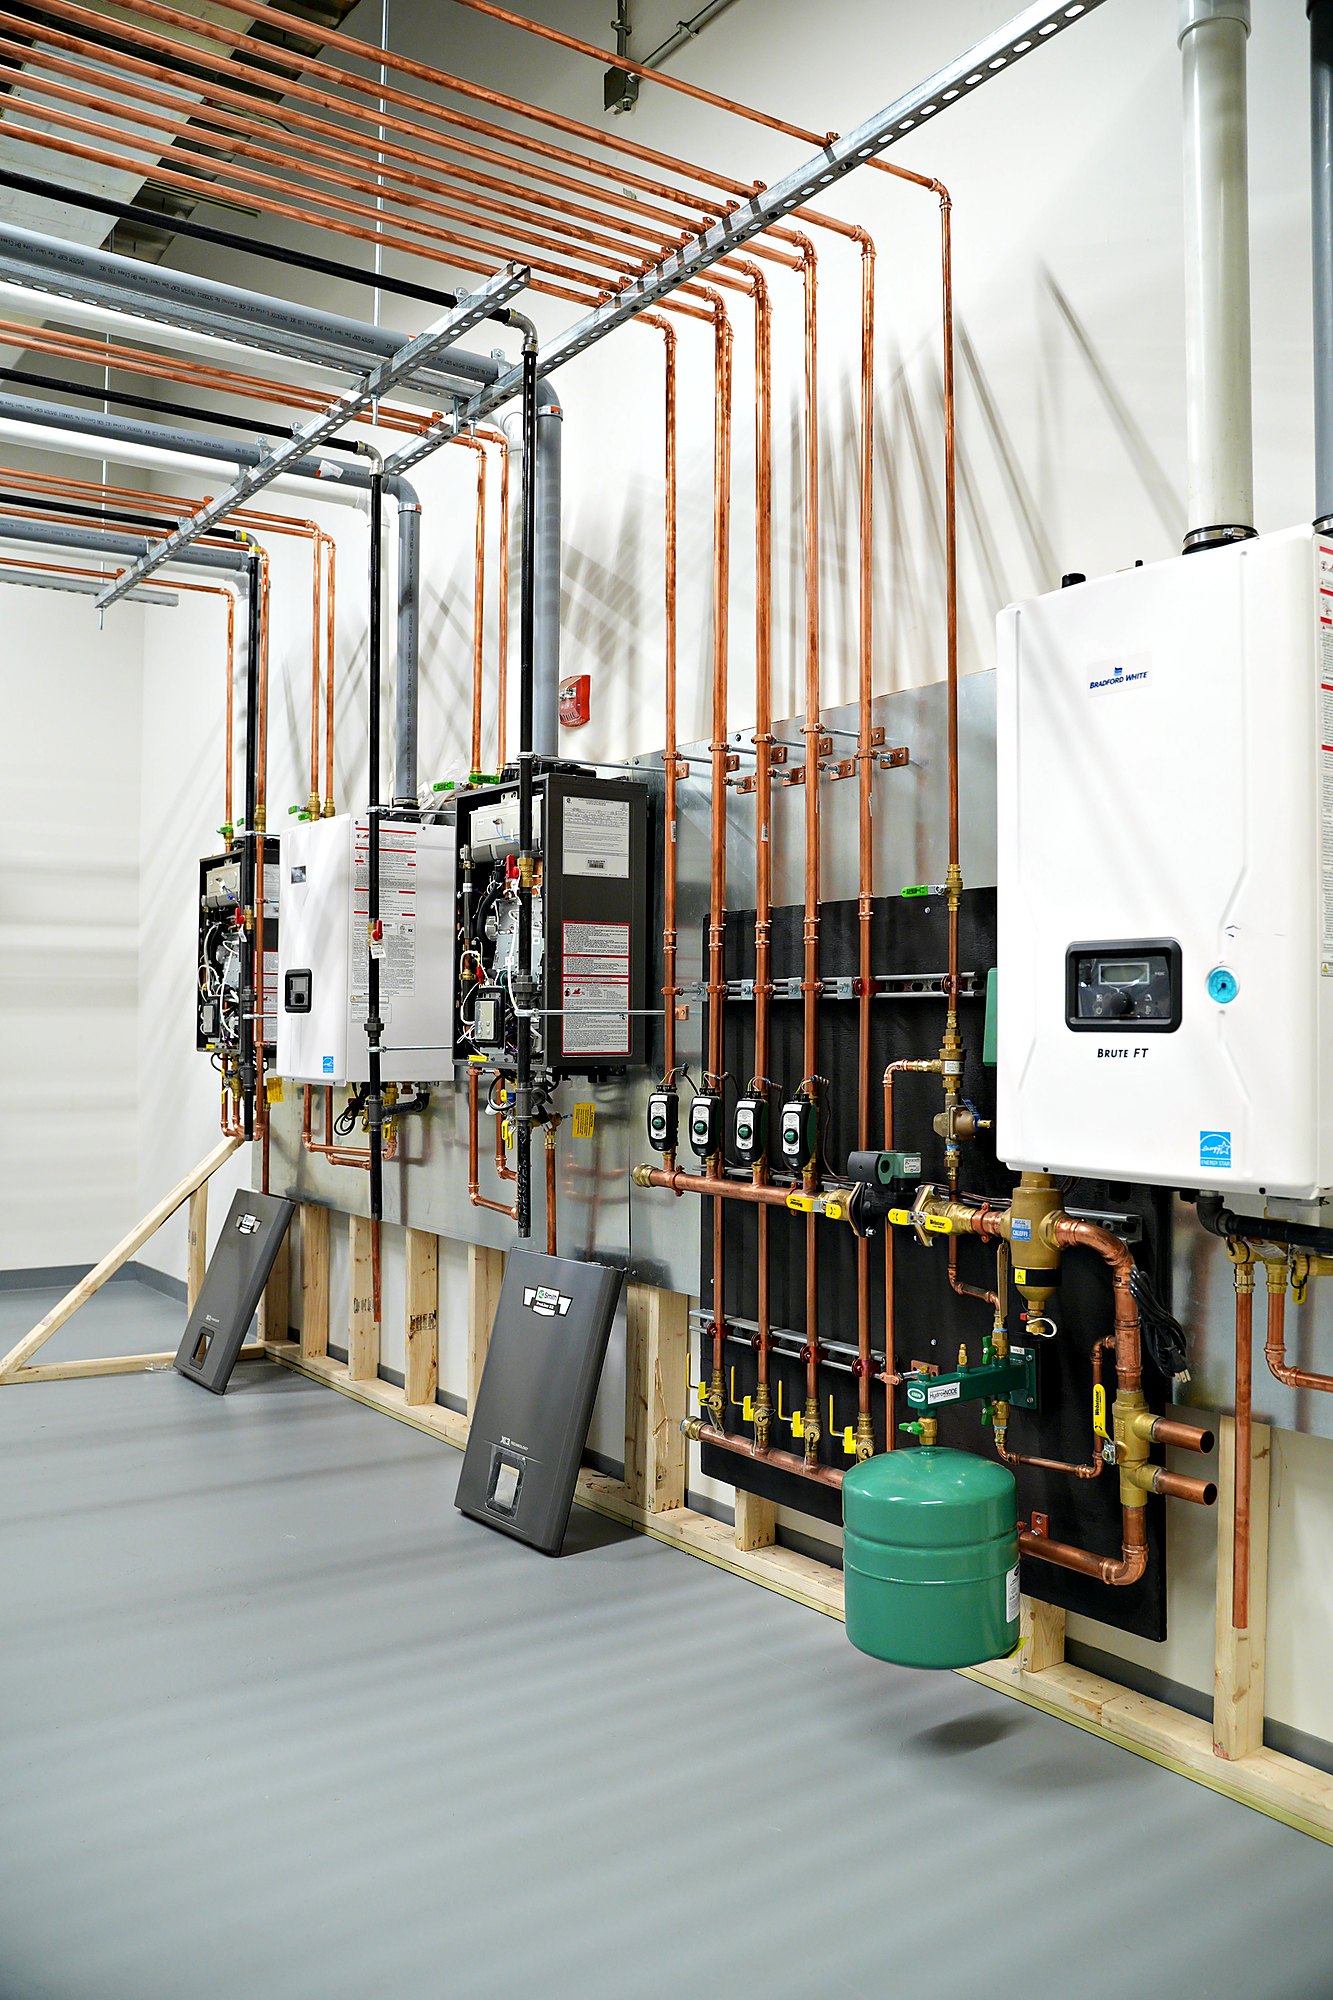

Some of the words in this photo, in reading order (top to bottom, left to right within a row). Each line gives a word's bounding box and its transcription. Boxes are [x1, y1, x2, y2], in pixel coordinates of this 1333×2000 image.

[1089, 676, 1124, 689] BRADFORD
[1125, 671, 1148, 681] WHITE
[1097, 1048, 1129, 1058] BRUTE
[1133, 1048, 1149, 1058] FT
